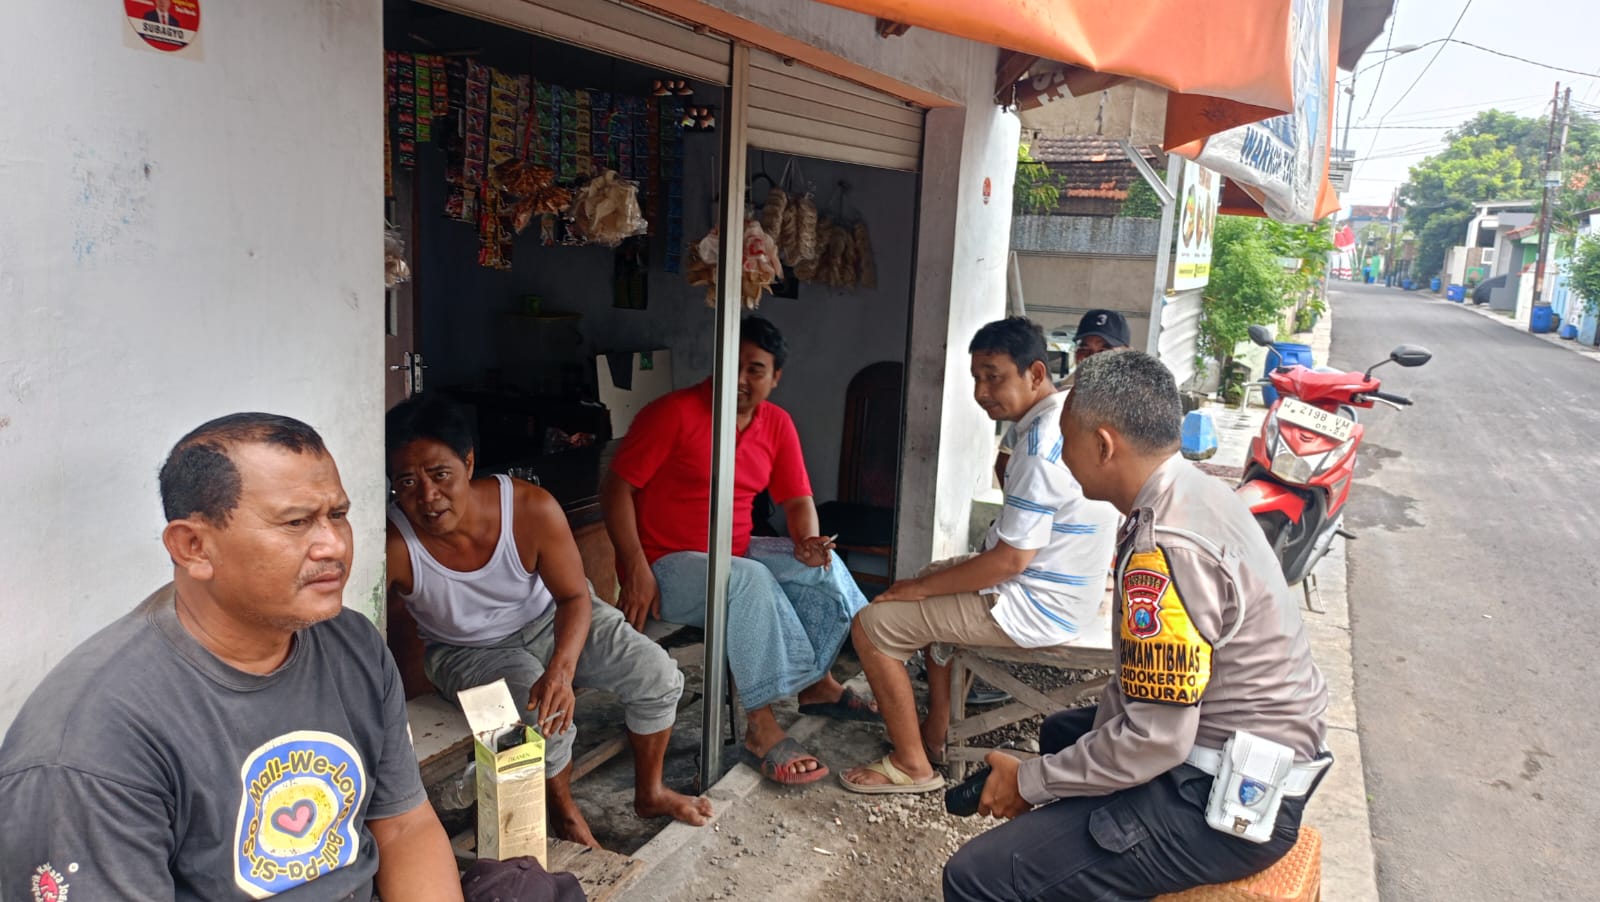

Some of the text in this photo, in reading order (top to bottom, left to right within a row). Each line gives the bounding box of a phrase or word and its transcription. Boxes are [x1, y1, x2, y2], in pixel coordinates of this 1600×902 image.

[142, 22, 184, 40] SUBAGYO
[1096, 314, 1108, 326] 3
[1299, 405, 1328, 422] 2198
[1122, 666, 1196, 687] SIDOKERTO
[1123, 682, 1199, 702] BUDURAN
